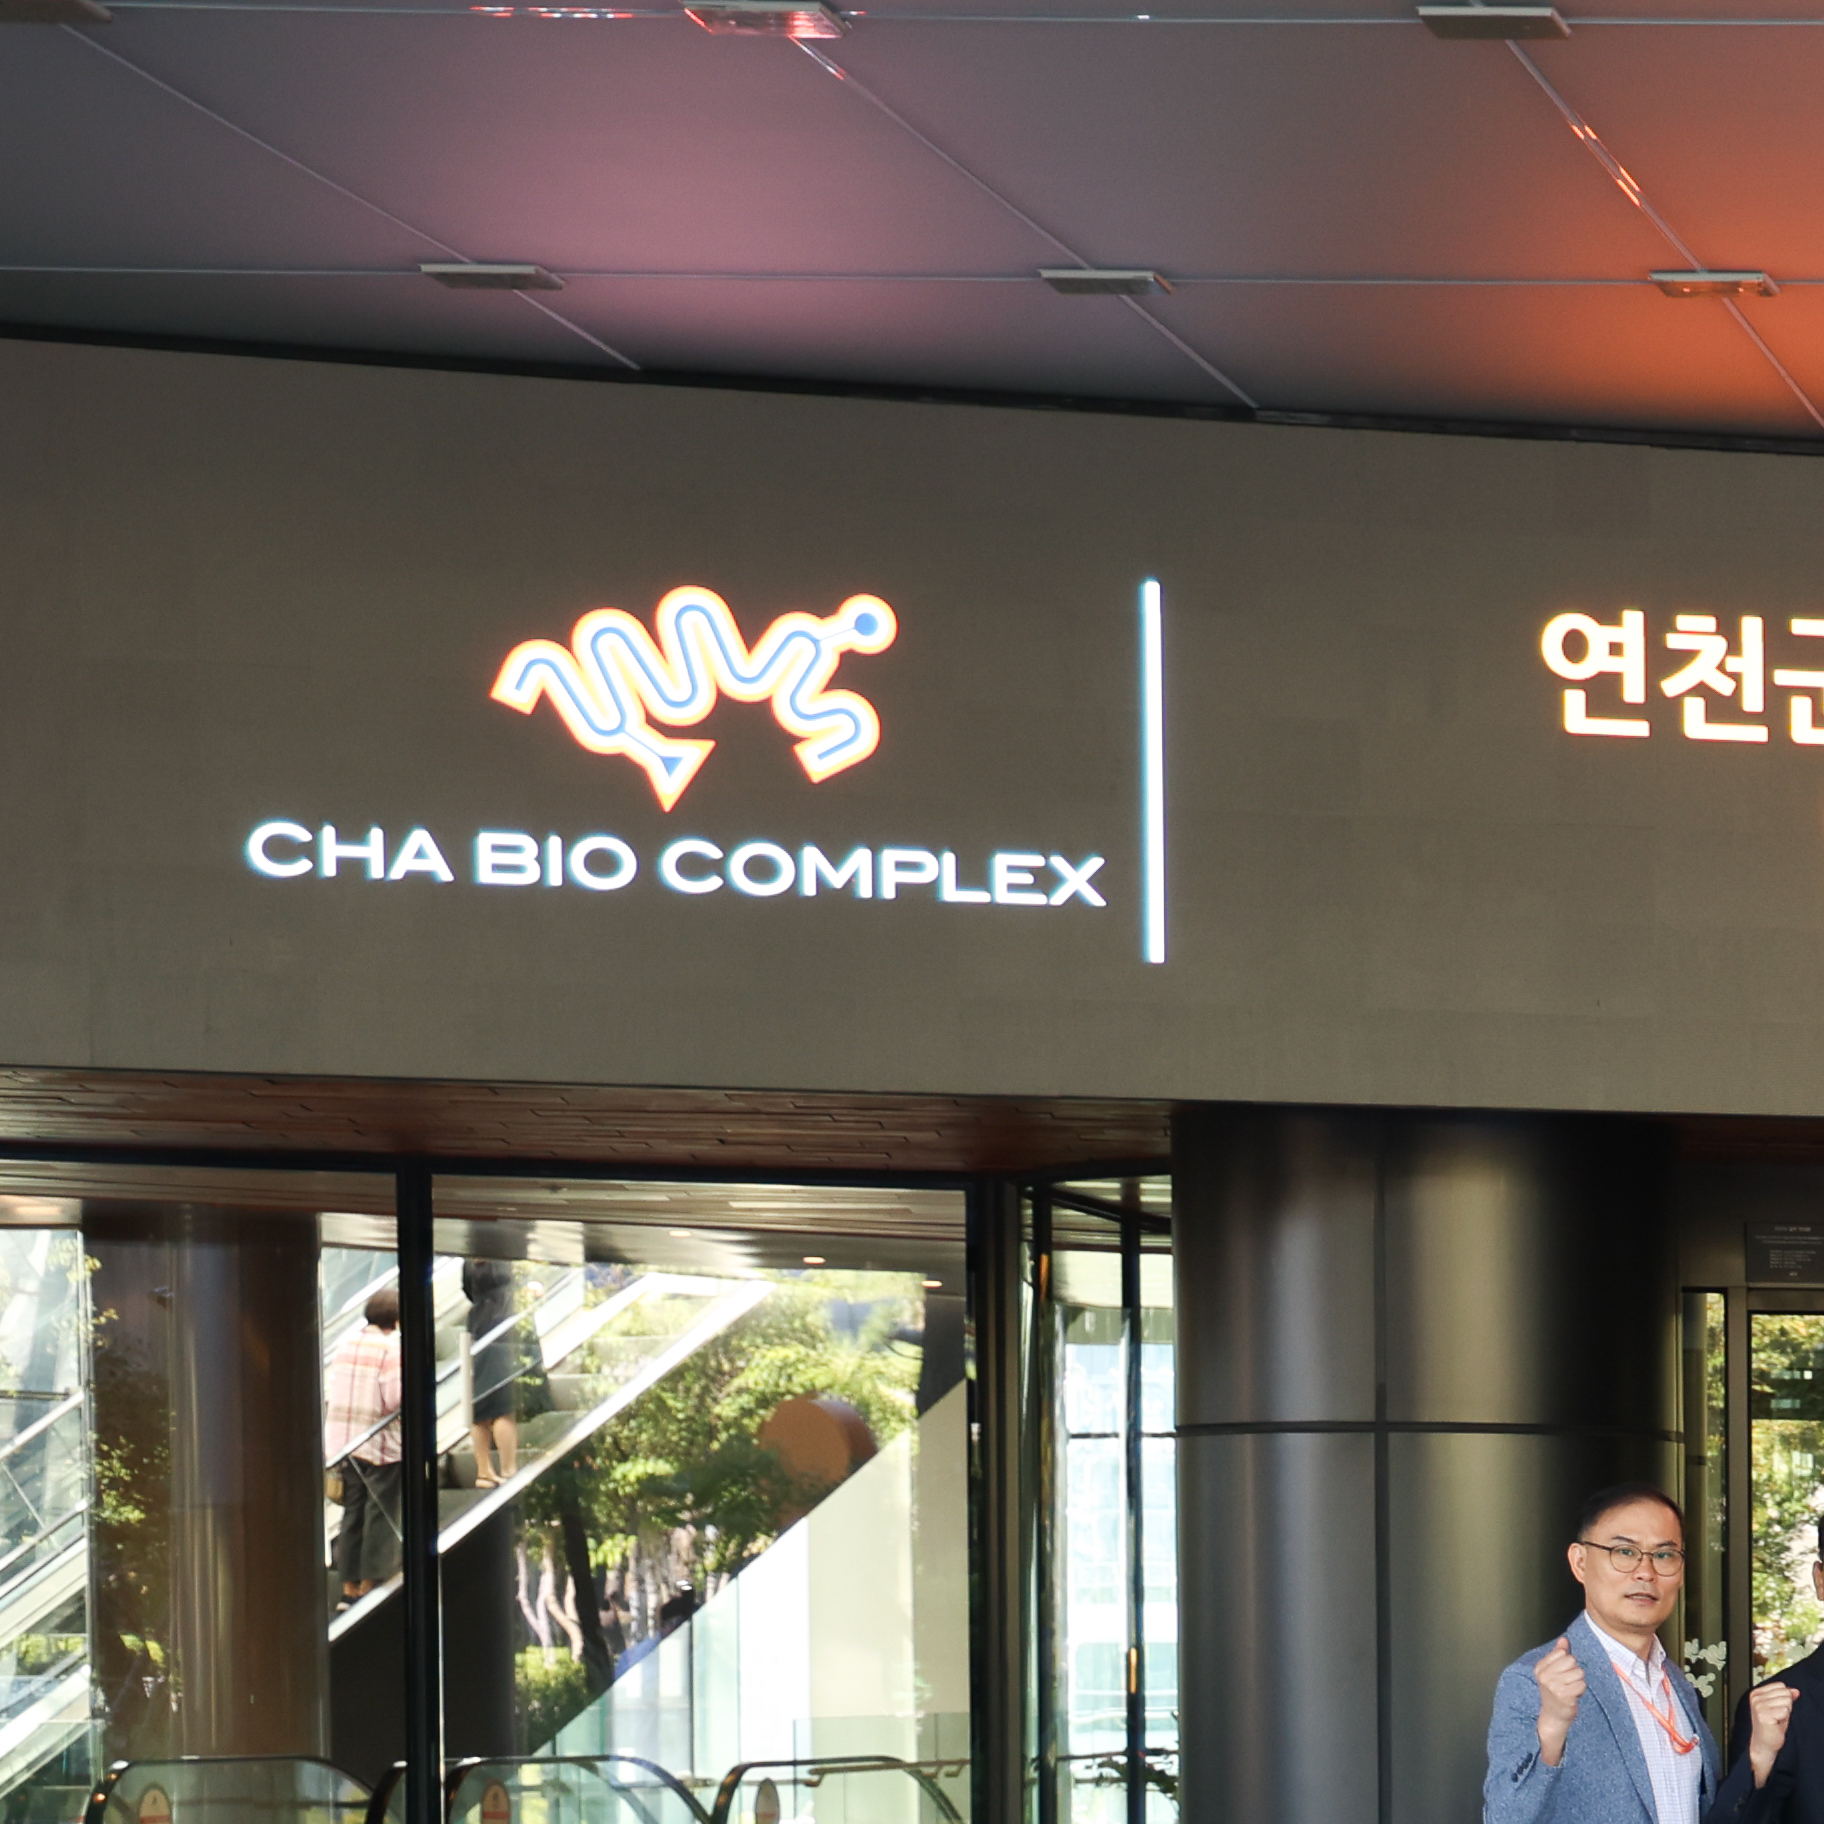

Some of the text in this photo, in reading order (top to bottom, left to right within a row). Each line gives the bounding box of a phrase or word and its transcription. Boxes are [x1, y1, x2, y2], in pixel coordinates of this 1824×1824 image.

[247, 821, 1106, 906] CHA BIO COMPLEX
